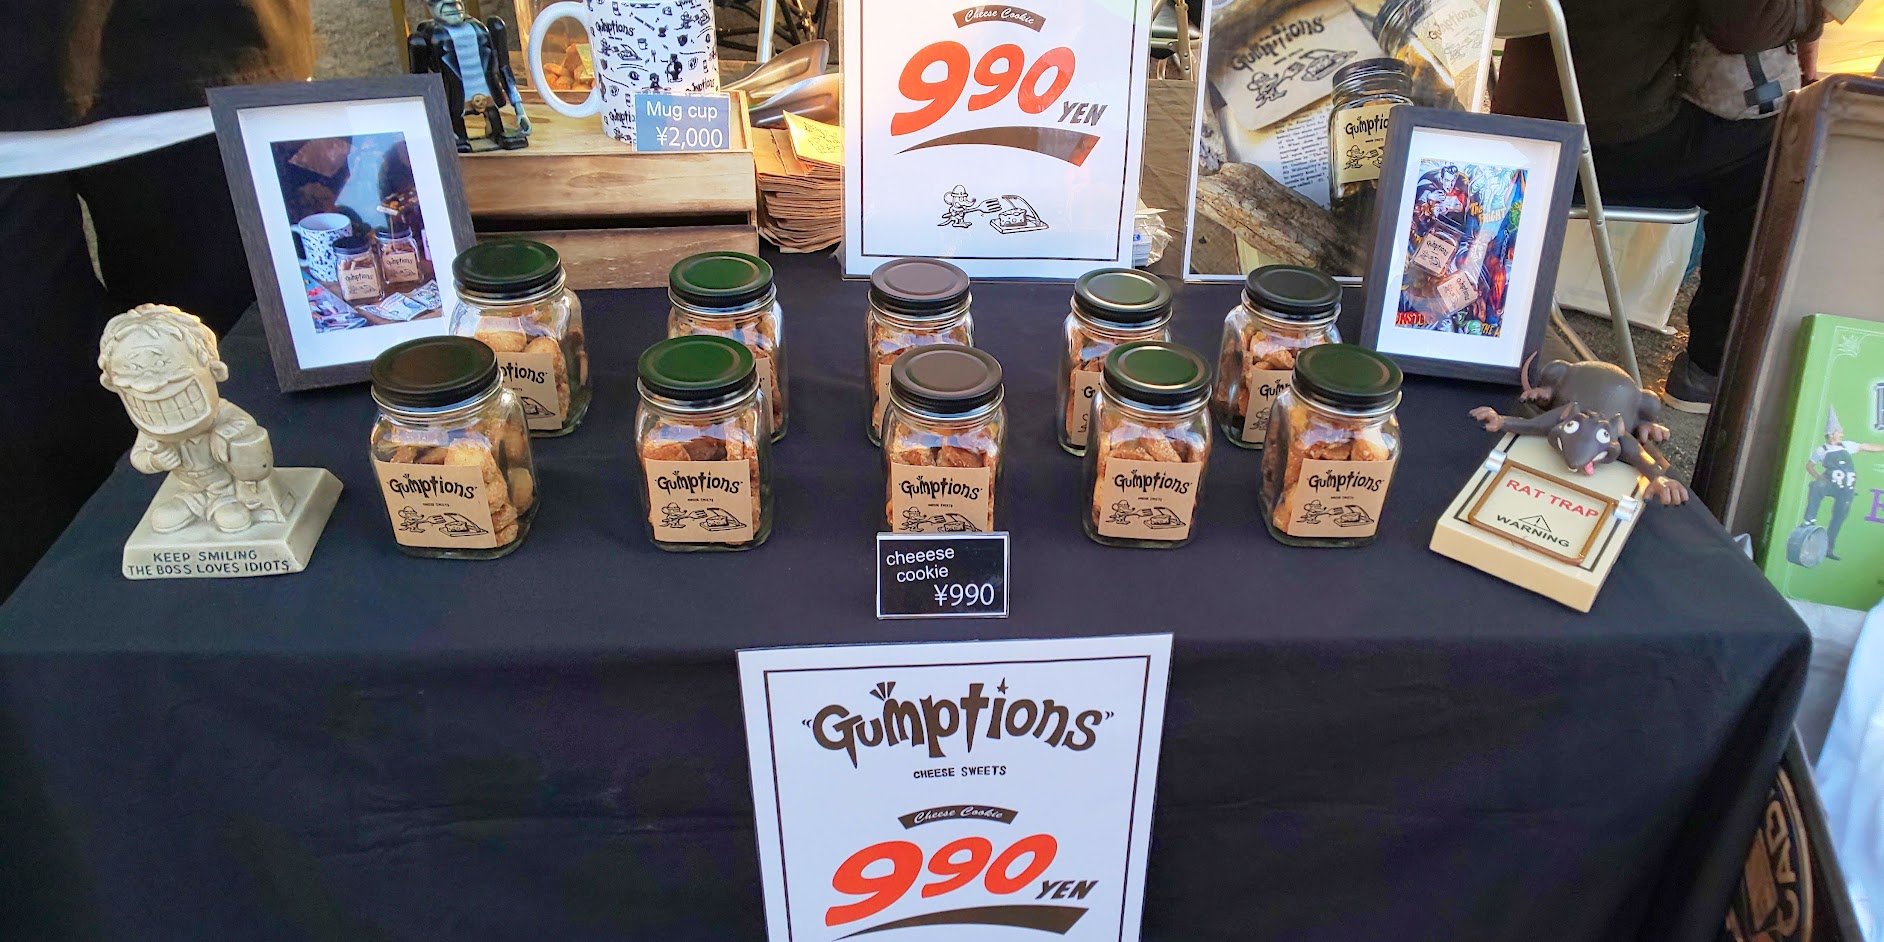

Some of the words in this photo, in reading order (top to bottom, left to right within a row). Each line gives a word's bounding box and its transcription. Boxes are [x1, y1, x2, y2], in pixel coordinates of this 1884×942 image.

[965, 9, 998, 22] Cheese
[1000, 8, 1034, 24] Cookie
[891, 40, 1076, 136] 990
[1057, 101, 1108, 126] YEN
[646, 100, 683, 121] Mug
[687, 106, 718, 122] cup
[655, 126, 723, 149] ¥2,000
[389, 473, 476, 499] Gumptions
[657, 470, 740, 495] Gumptions
[901, 475, 980, 500] Gumptions
[1114, 469, 1190, 494] Gumptions
[1308, 470, 1382, 493] Gumptions
[1506, 479, 1545, 498] RAT
[1550, 495, 1599, 517] TRAP
[1496, 514, 1570, 547] WARNING
[127, 564, 153, 576] THE
[157, 564, 192, 575] BOSS
[196, 562, 240, 574] LOVES
[244, 560, 290, 572] IDIOTS
[153, 552, 190, 563] KEEP
[198, 550, 258, 561] SMILING
[886, 548, 955, 565] cheeese
[896, 564, 949, 582] cookie
[933, 583, 995, 607] ¥990
[913, 767, 956, 779] CHEESE
[961, 765, 1007, 777] SWEETS
[914, 810, 956, 823] Cheese
[960, 806, 1003, 819] Cookie
[825, 833, 1058, 927] 990
[1034, 880, 1099, 900] YEN
